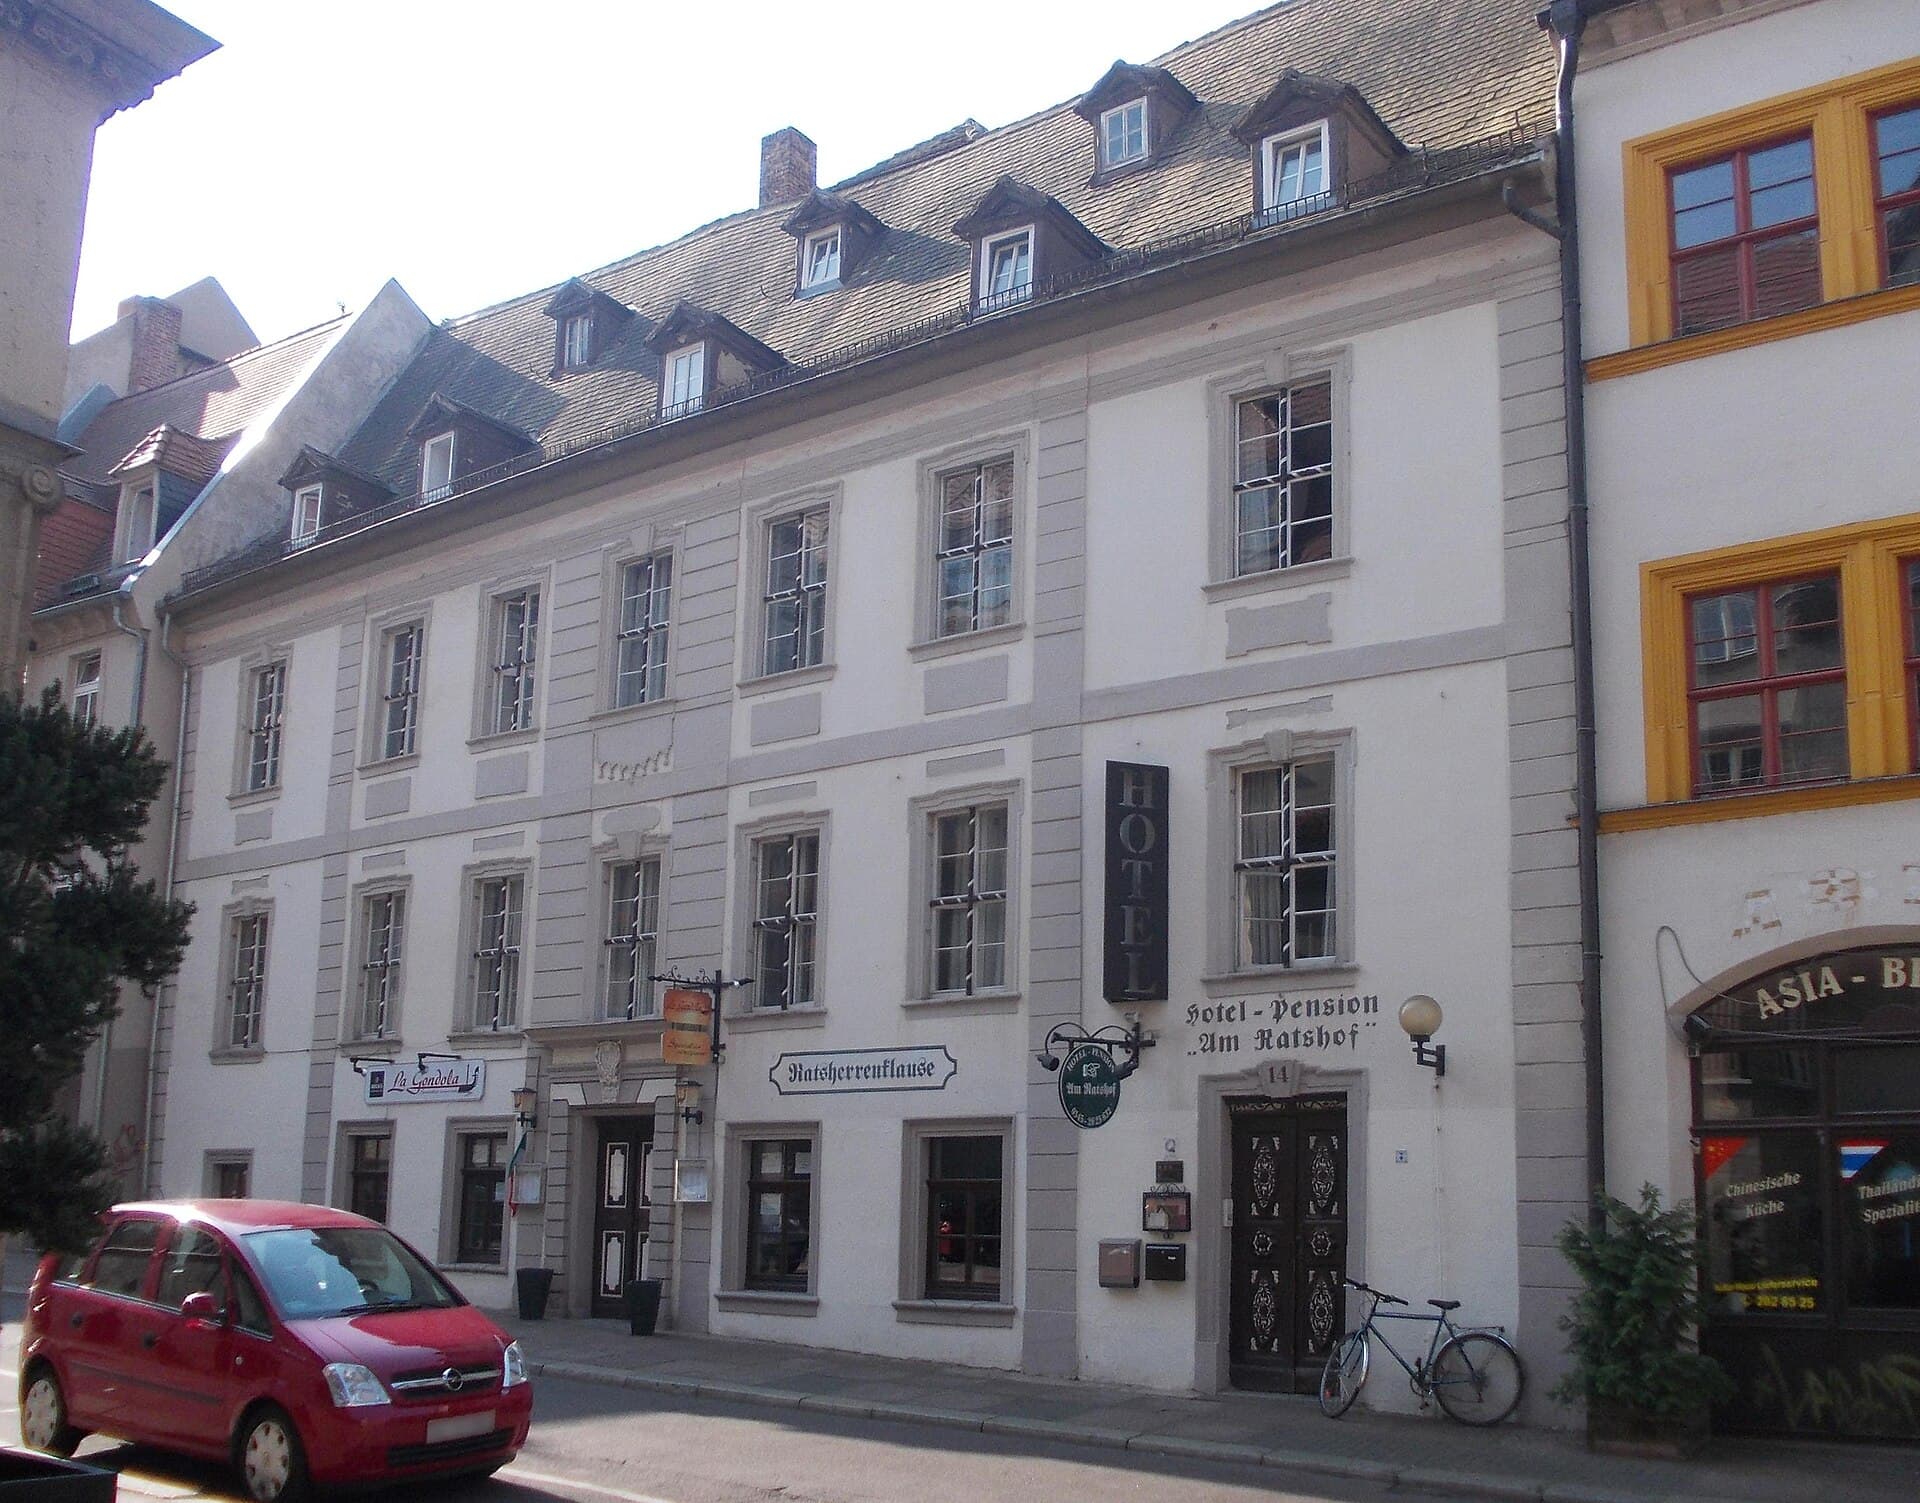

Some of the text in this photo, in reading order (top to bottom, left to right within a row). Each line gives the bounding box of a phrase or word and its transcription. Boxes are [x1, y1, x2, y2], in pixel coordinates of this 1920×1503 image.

[1118, 767, 1156, 993] HOTEL
[1755, 965, 1845, 1020] ASIA
[1185, 1000, 1246, 1026] Hotel
[1269, 993, 1379, 1024] Pension
[387, 1068, 459, 1094] La Gondola
[788, 1058, 935, 1088] Ratsherrenklause
[1269, 1065, 1289, 1083] 14
[1066, 1082, 1116, 1099] Am Ratshof
[1725, 1172, 1801, 1197] Chinesische
[1745, 1200, 1785, 1218] Küche
